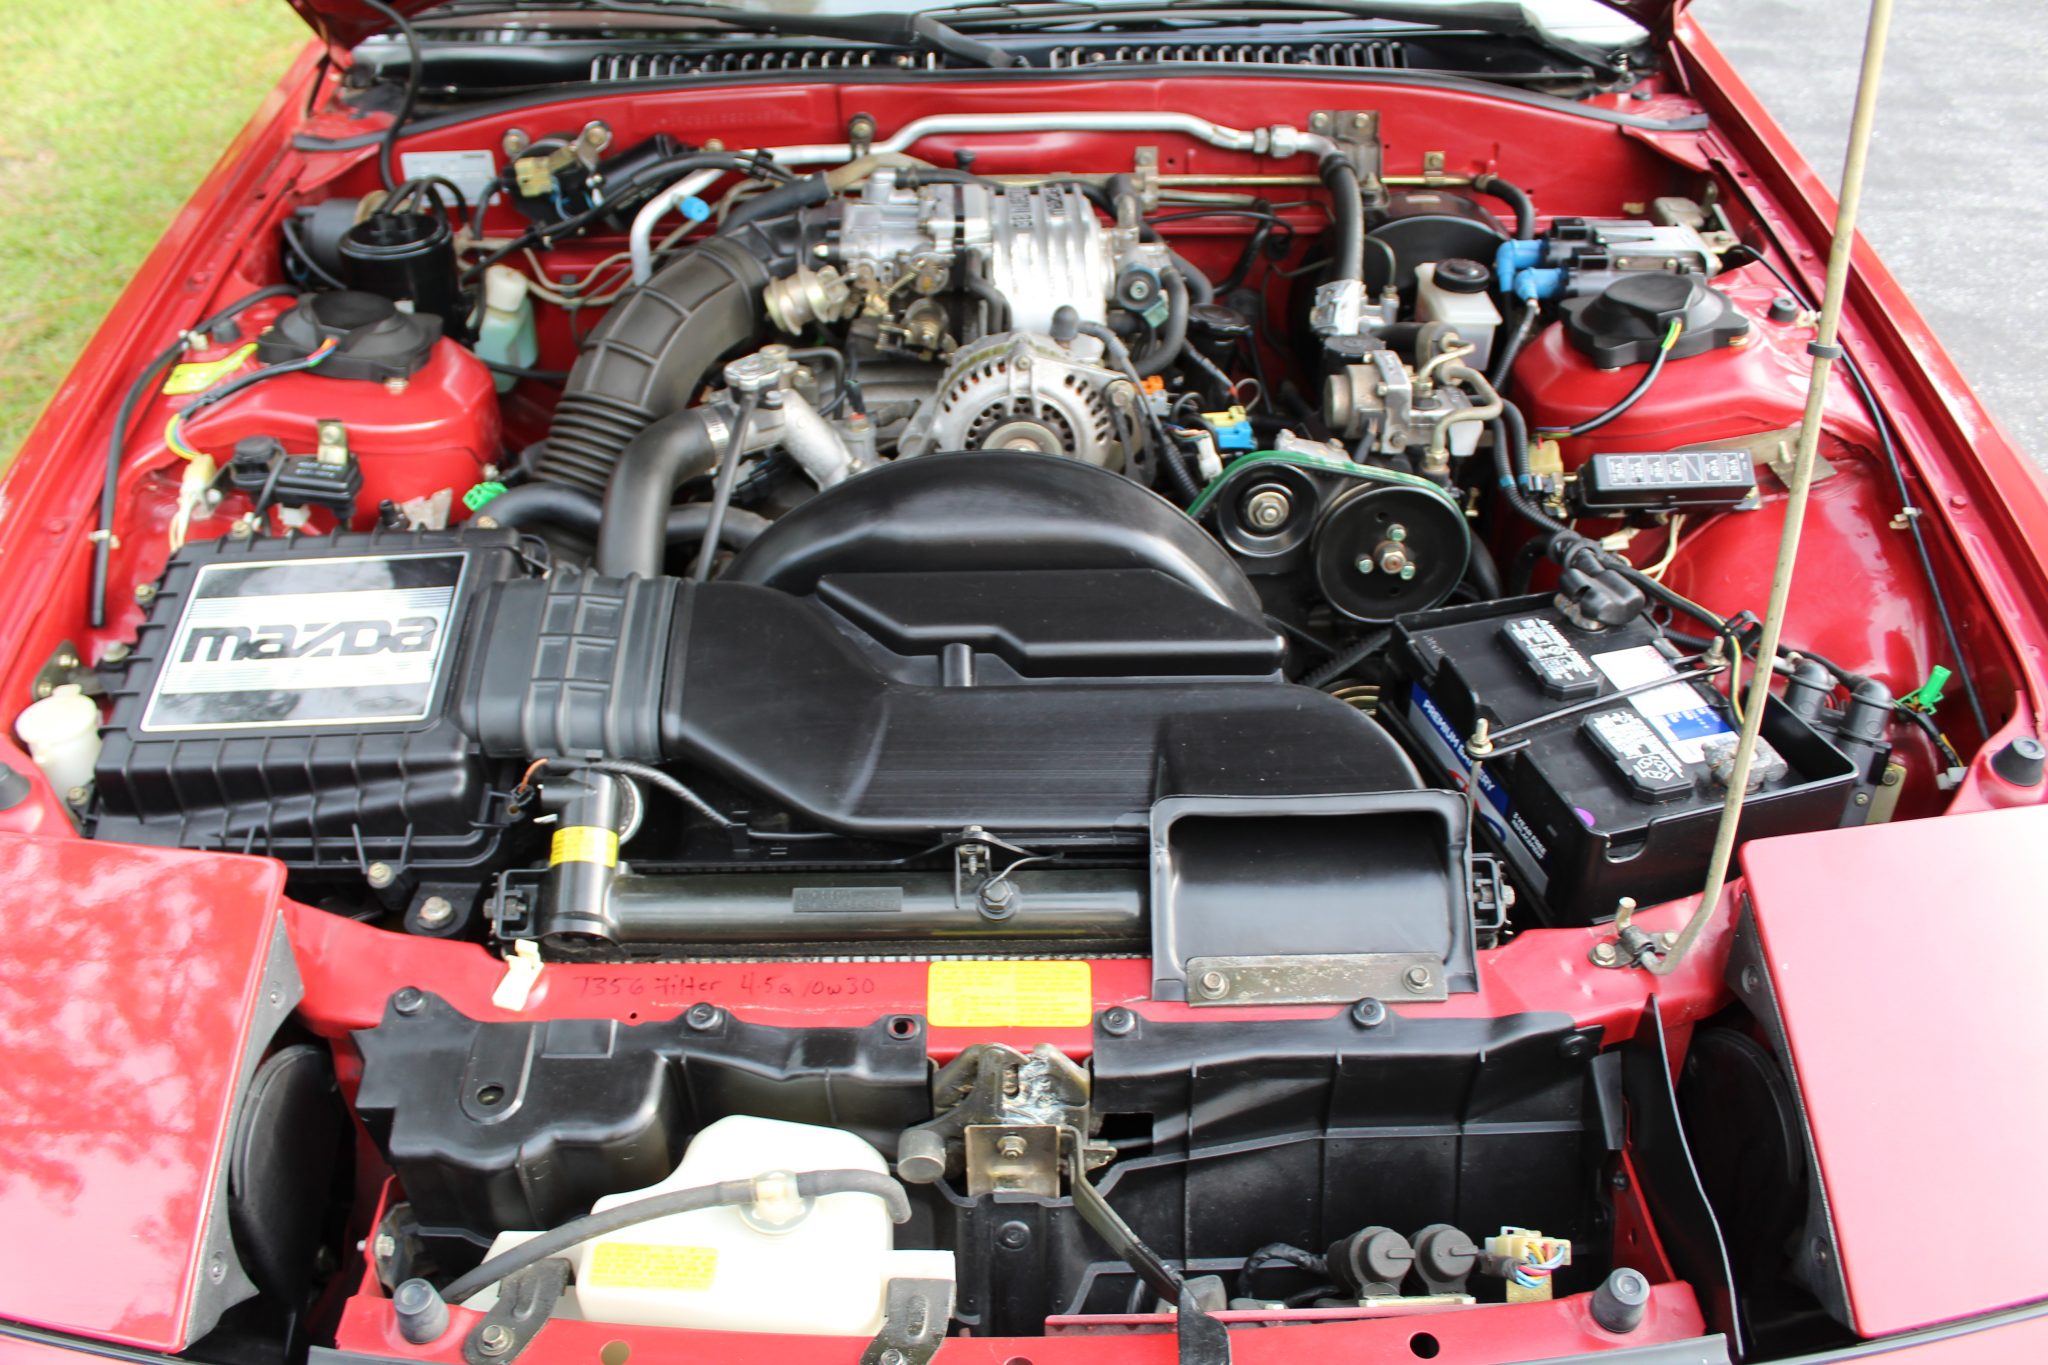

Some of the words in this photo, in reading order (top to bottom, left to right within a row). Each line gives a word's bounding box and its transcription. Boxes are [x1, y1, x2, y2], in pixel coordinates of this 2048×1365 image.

[1422, 698, 1460, 748] PREMIUM
[1456, 743, 1495, 791] BAERY
[573, 976, 644, 998] 7356
[655, 973, 722, 996] Filter
